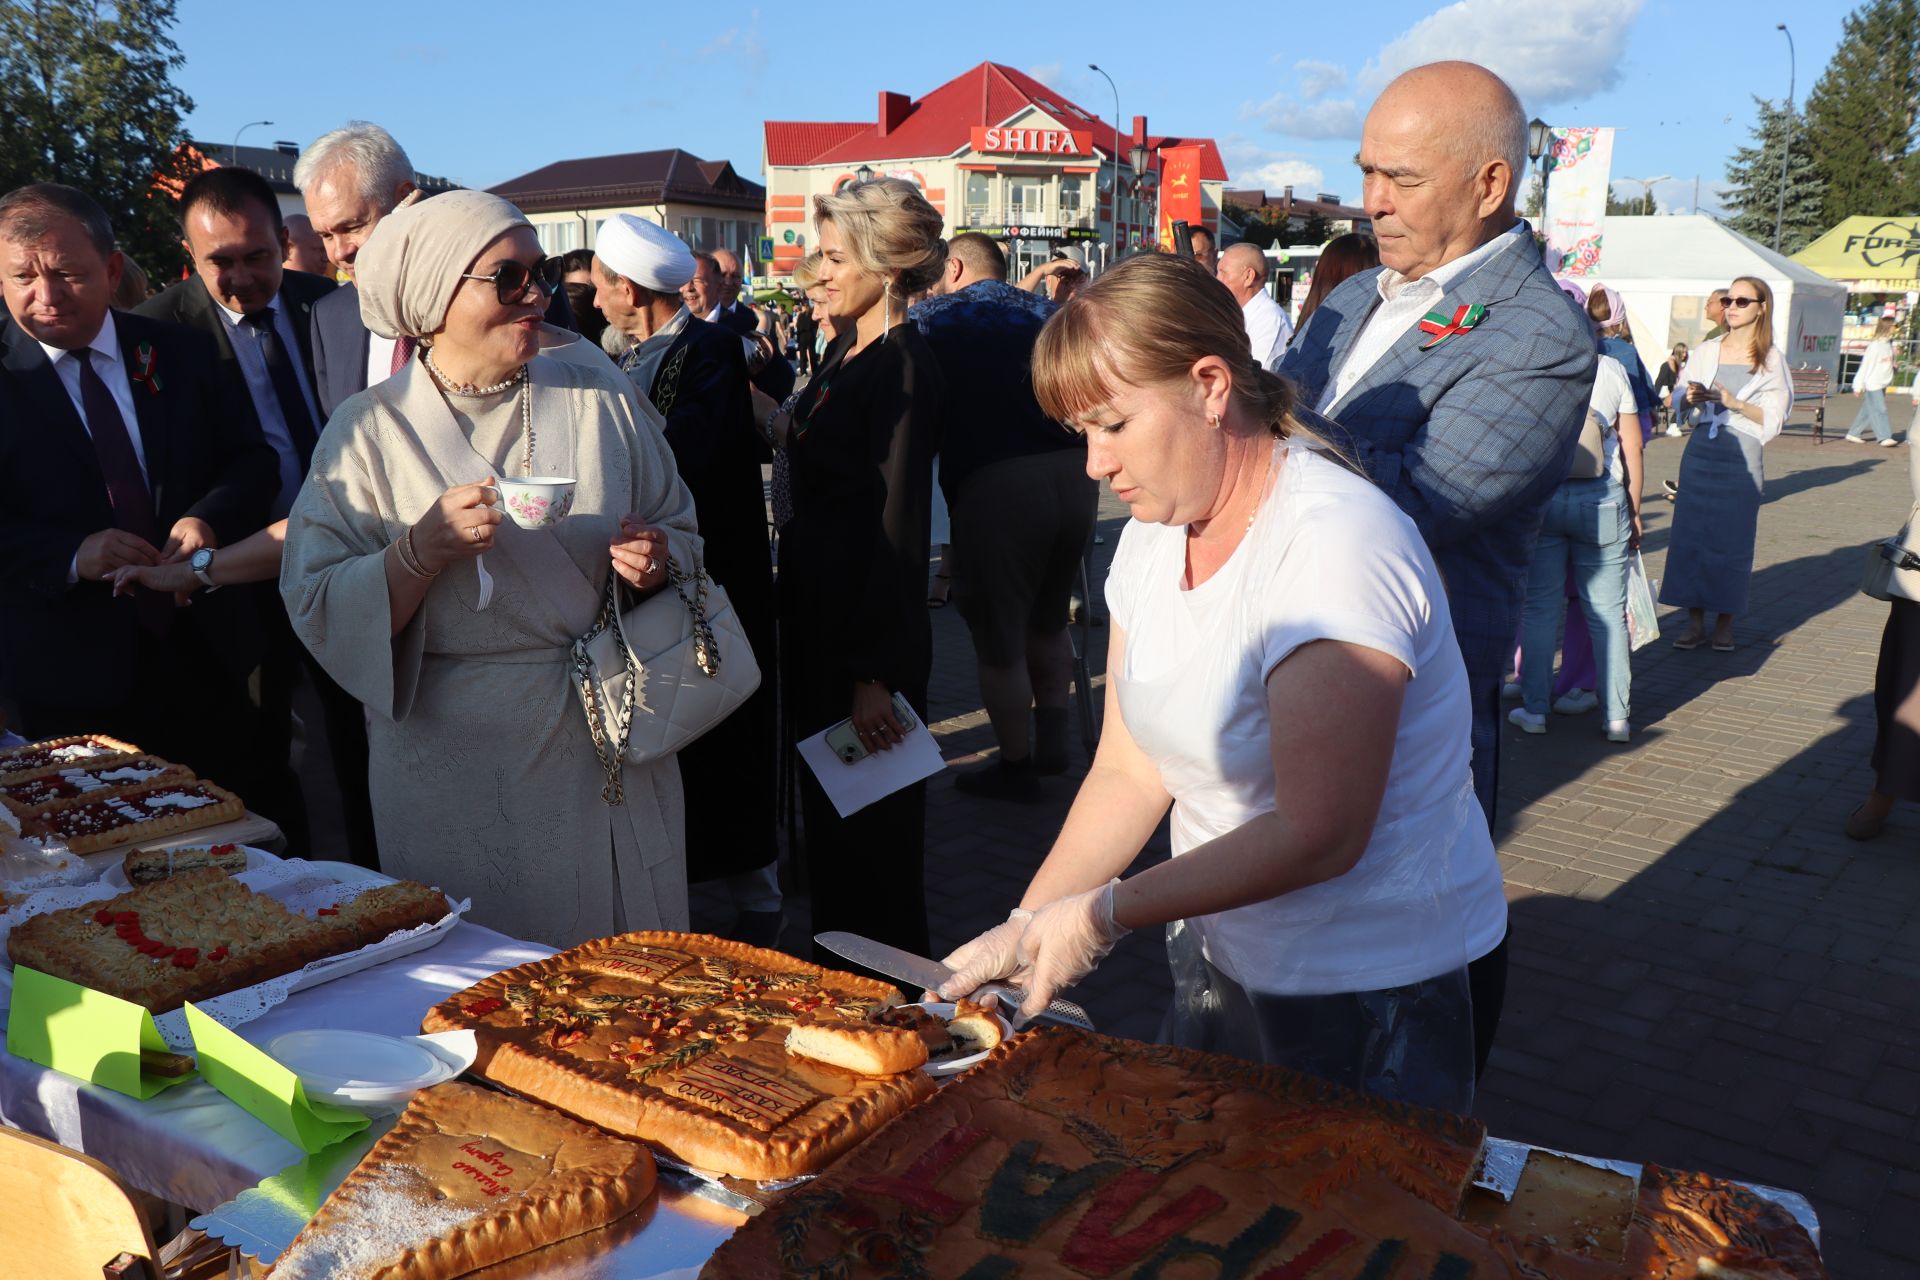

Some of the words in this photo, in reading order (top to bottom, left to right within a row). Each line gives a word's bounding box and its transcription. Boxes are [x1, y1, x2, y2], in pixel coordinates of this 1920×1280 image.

[985, 128, 1079, 153] SHIFA
[1003, 227, 1062, 237] КОФЕЙНЯ
[1803, 335, 1837, 352] TATNEFT
[677, 1083, 725, 1105] КОГО
[732, 1087, 784, 1112] КАФЕ
[730, 1105, 761, 1120] ОТ
